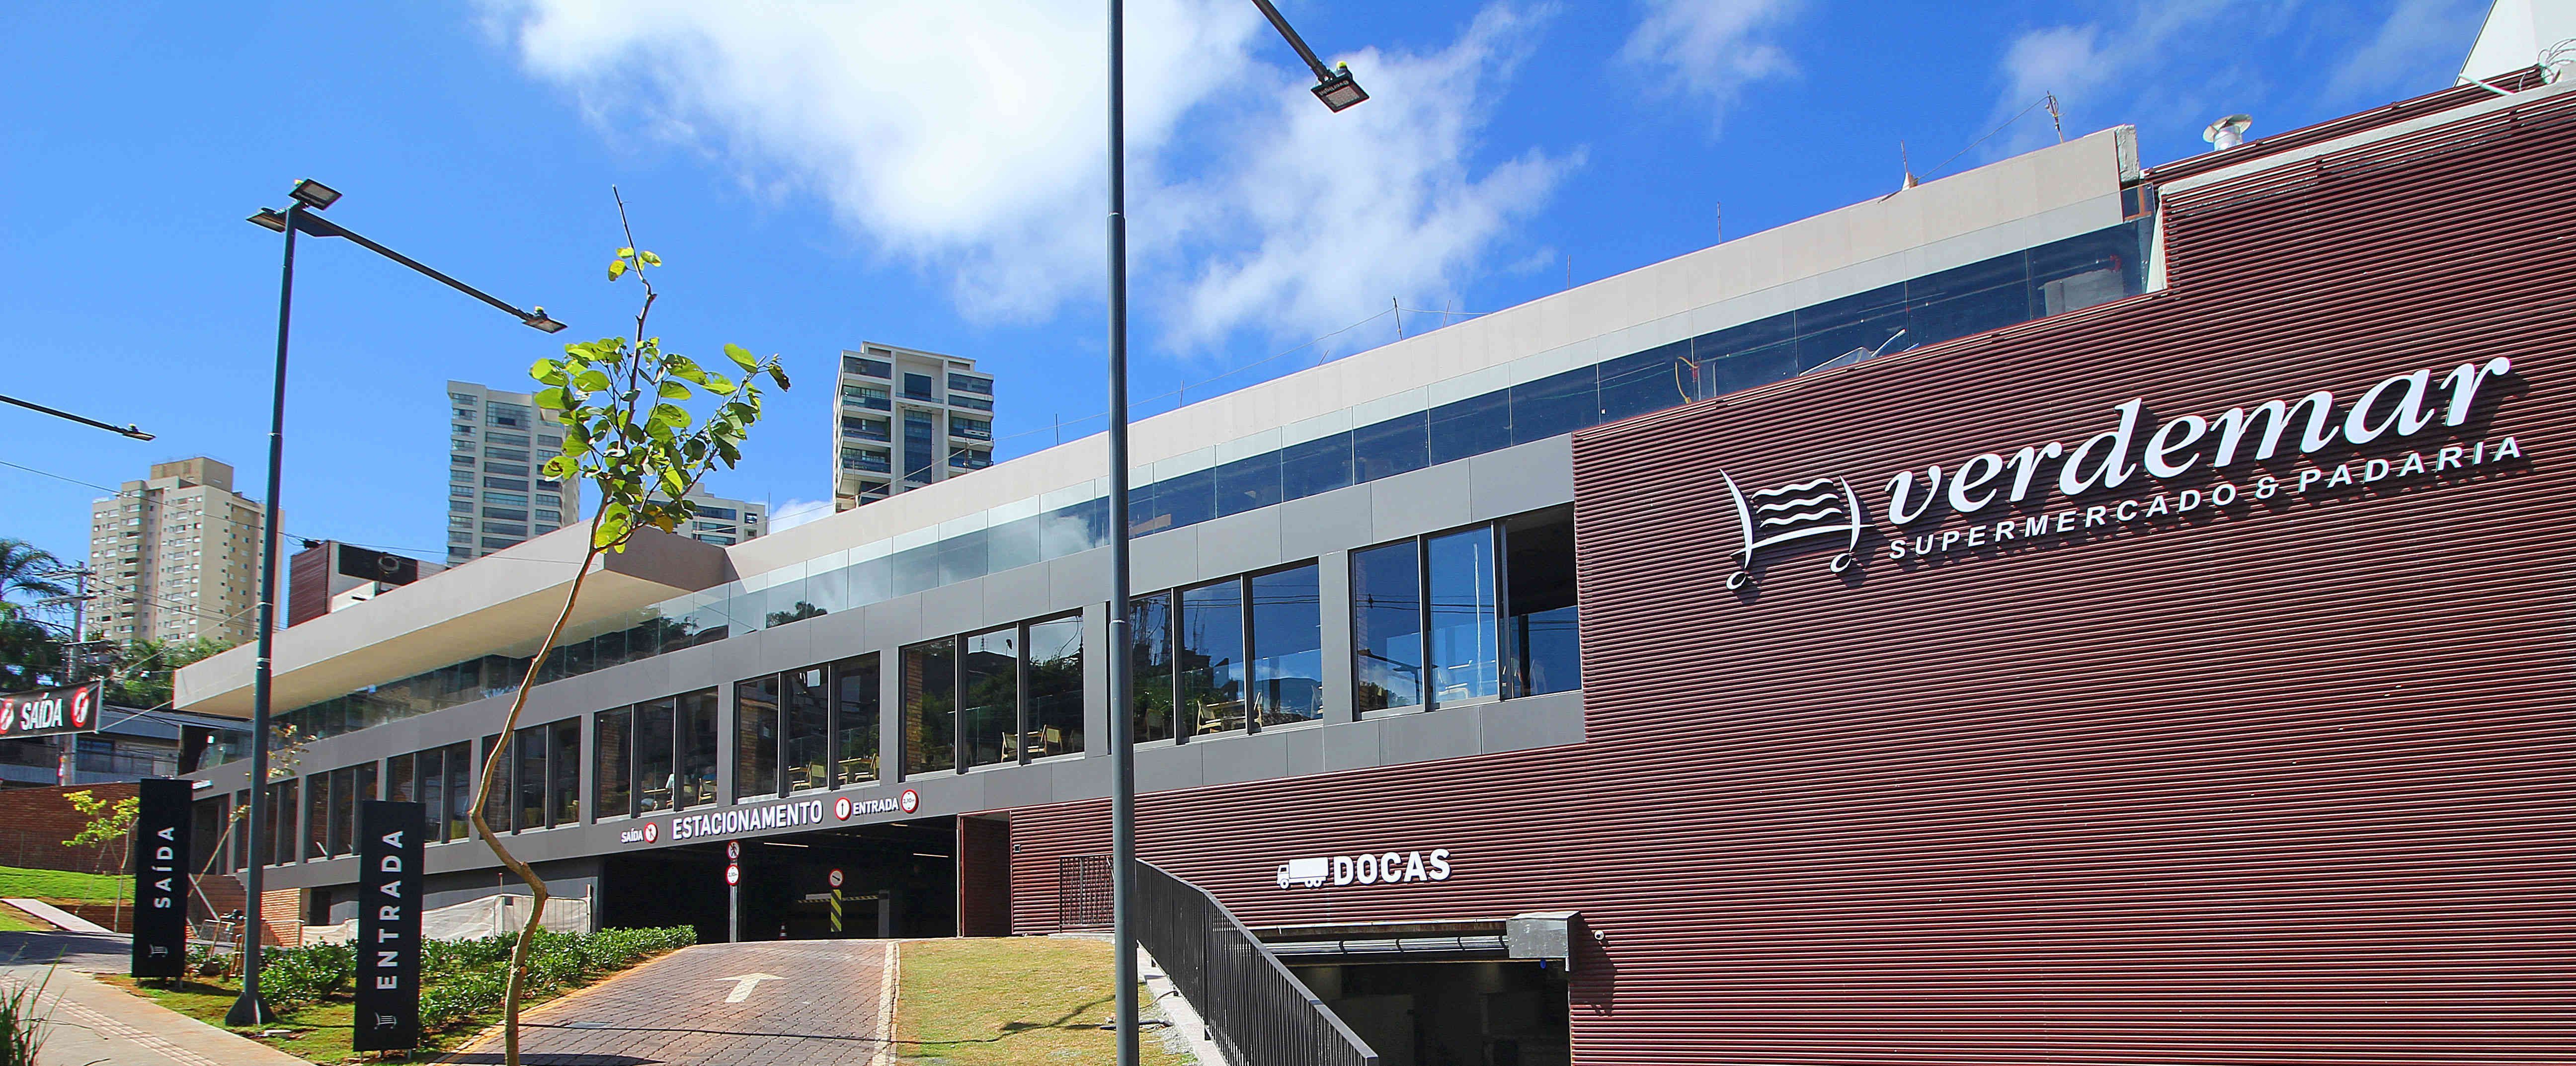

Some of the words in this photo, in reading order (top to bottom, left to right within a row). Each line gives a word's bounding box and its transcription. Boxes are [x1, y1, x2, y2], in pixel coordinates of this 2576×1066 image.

[1884, 356, 2511, 525] verdemar
[1889, 483, 2236, 559] SUPERMERCADO
[2255, 476, 2280, 499] &
[2299, 436, 2521, 493] PADARIA
[20, 692, 63, 730] SAÍDA
[672, 800, 823, 840] ESTACIONAMENTO
[852, 797, 899, 815] ENTRADA
[621, 828, 644, 843] SAÍDA
[153, 827, 175, 909] SAÍDA
[1333, 848, 1451, 886] DOCAS
[376, 830, 403, 990] ENTRADA
